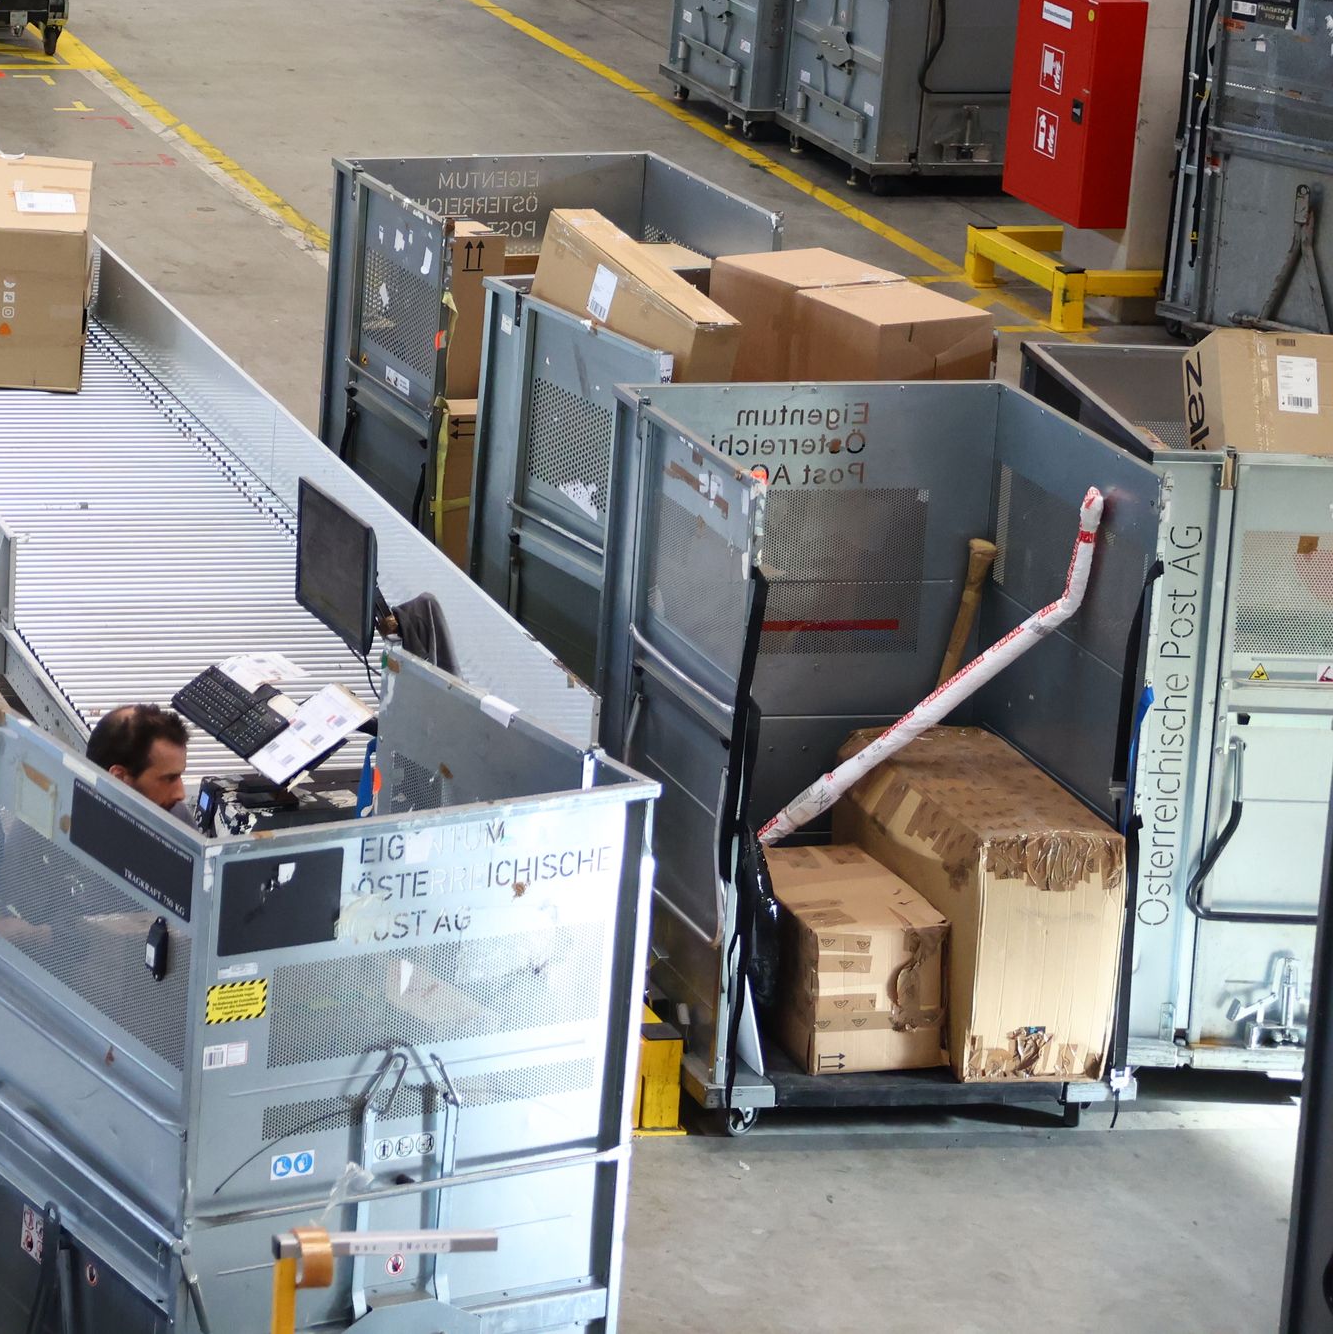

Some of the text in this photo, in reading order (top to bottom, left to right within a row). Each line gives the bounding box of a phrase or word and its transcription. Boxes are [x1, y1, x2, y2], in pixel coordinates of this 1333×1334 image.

[1186, 351, 1211, 450] zal
[1159, 588, 1198, 659] Post
[360, 820, 506, 865] EIGNTUM
[123, 867, 162, 900] TRAGKRAFT
[174, 903, 186, 917] KG
[357, 845, 613, 902] ÖSTERREICHISCHE
[371, 905, 472, 943] OST AG
